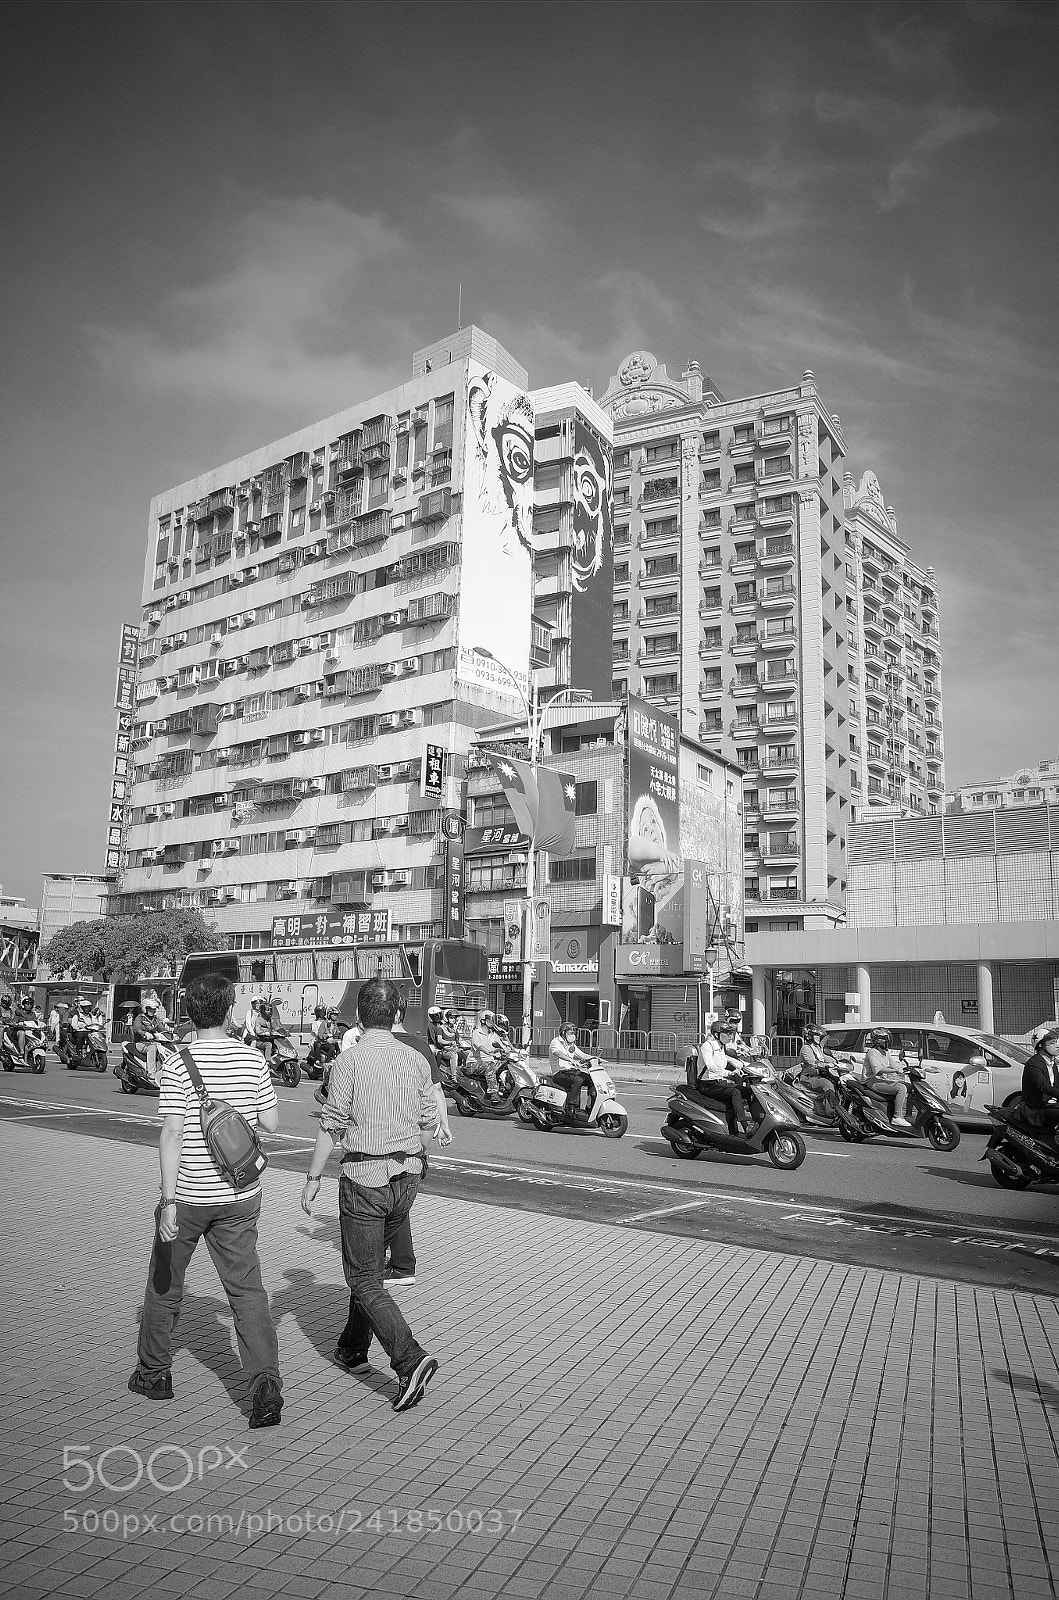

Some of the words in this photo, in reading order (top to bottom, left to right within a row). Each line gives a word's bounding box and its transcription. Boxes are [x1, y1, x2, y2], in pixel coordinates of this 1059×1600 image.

[428, 757, 442, 786] 租車
[272, 912, 388, 938] 高明一對一補習班
[550, 960, 599, 974] Yamazaki
